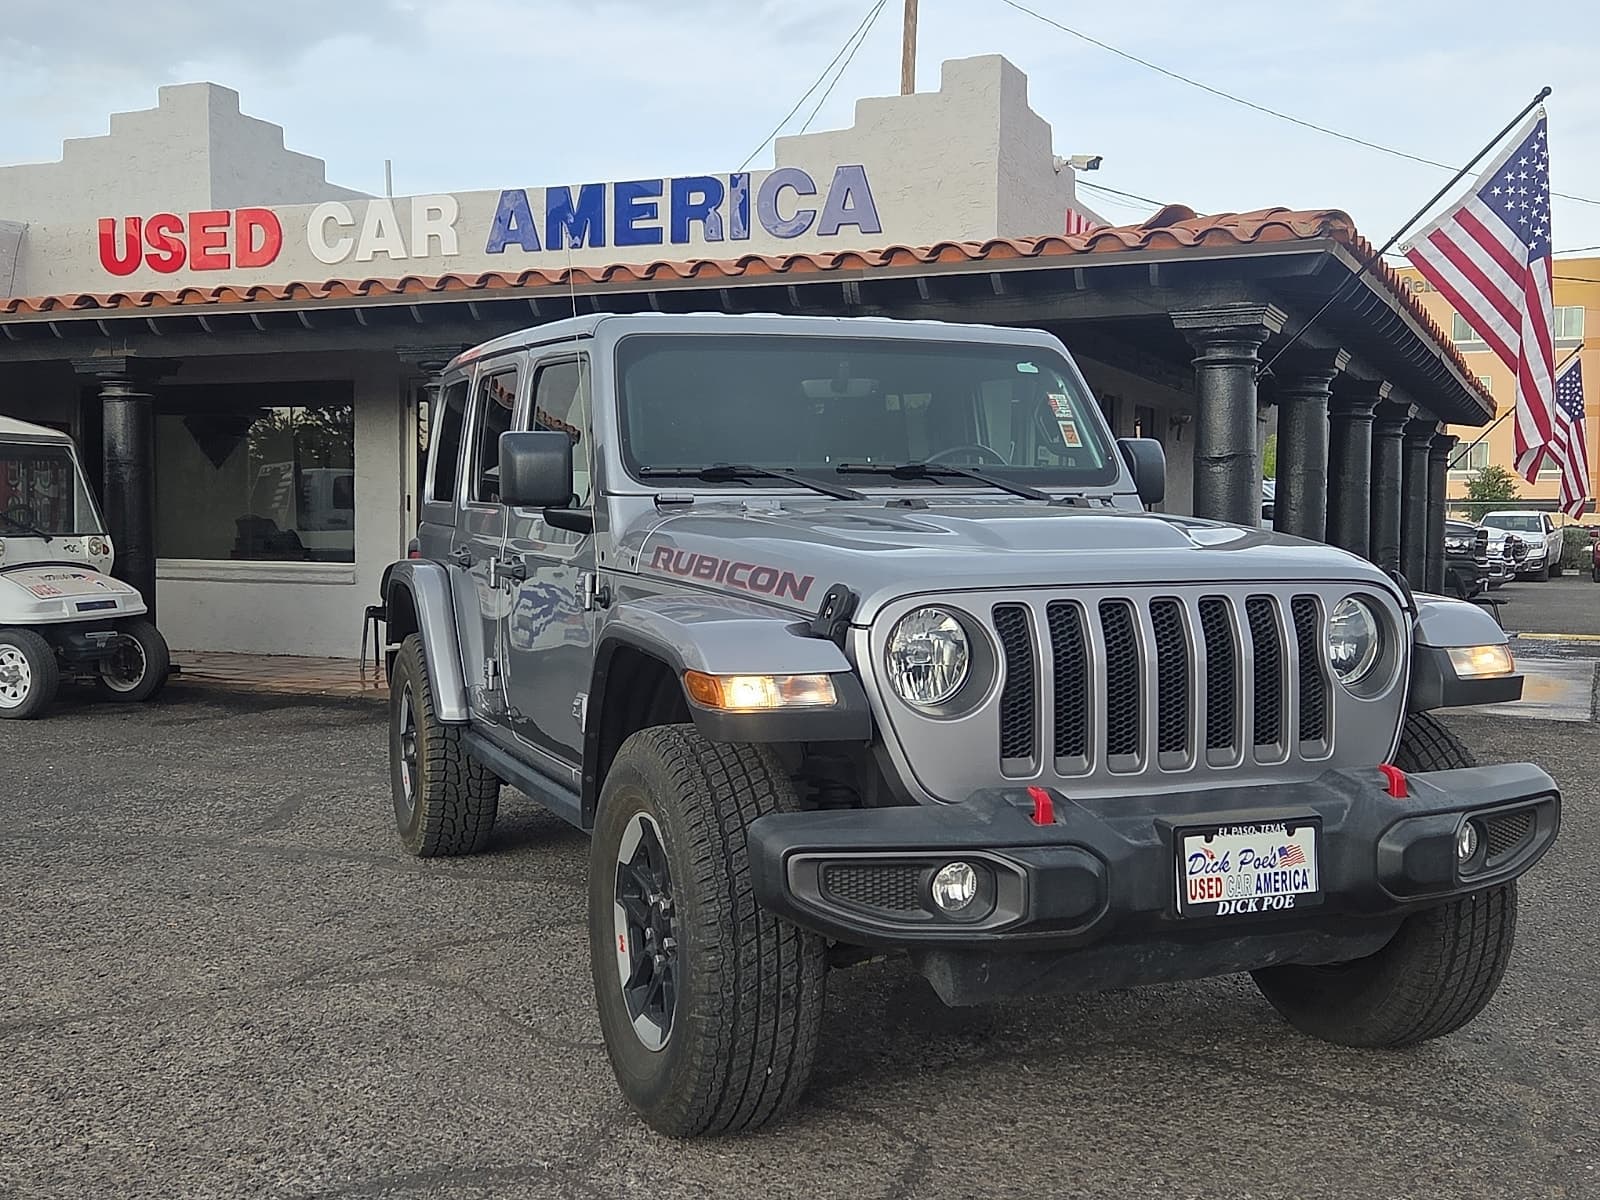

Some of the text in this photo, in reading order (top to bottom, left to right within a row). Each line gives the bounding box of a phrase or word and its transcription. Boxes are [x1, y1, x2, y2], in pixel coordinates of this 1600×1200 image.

[97, 164, 882, 276] USED CAR AMERICA
[651, 546, 815, 602] RUBICON
[1260, 822, 1286, 834] TEXAS
[1188, 846, 1278, 875] Dick Poe's
[1189, 868, 1309, 900] USED CAR AMERICA
[1216, 894, 1296, 915] DICK POE
